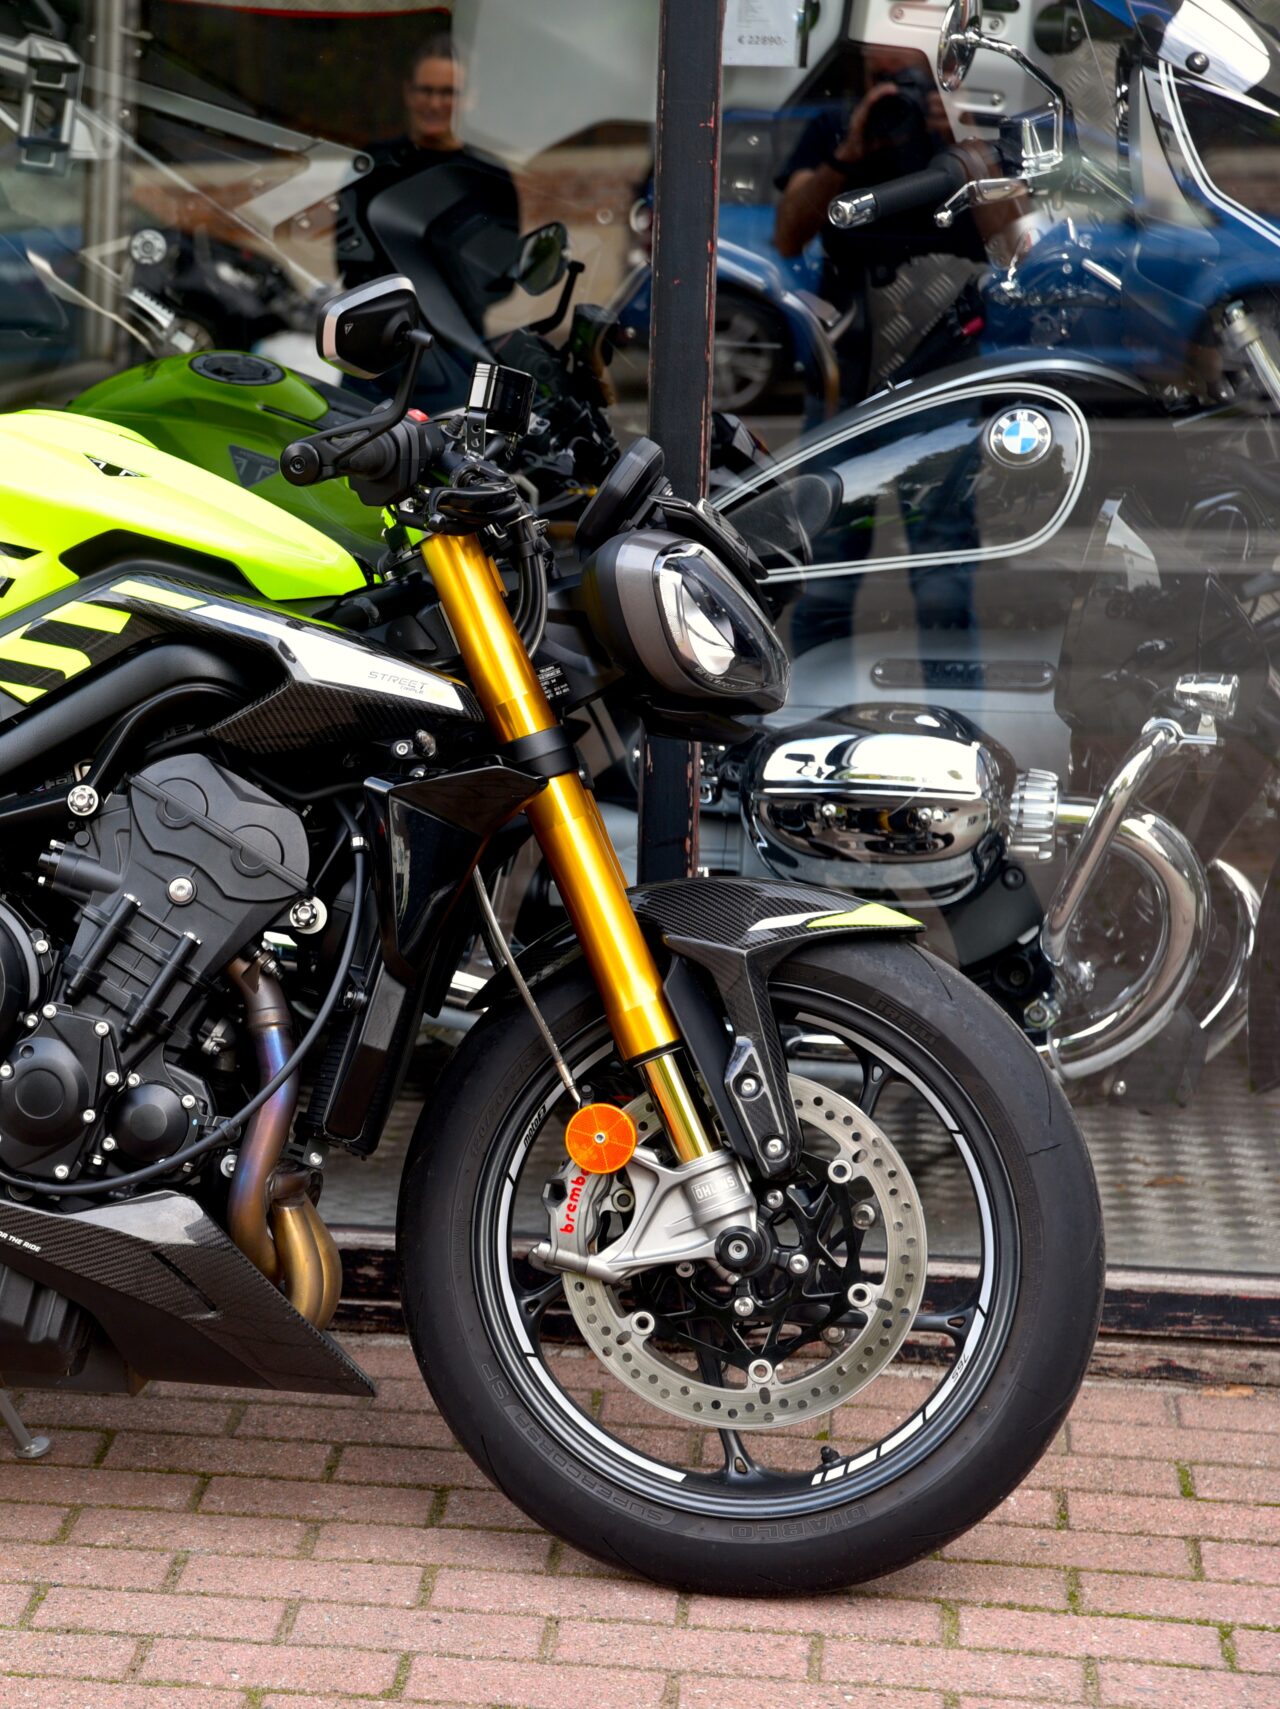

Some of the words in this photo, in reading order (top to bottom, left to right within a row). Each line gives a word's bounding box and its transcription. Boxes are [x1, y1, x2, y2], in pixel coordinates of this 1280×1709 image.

[368, 671, 429, 690] STREET
[8, 1235, 24, 1245] THE
[22, 1241, 41, 1252] RIDE
[481, 1363, 509, 1400] SP
[514, 1412, 664, 1522] SUPERCORSA
[731, 1503, 871, 1539] DIABLO
